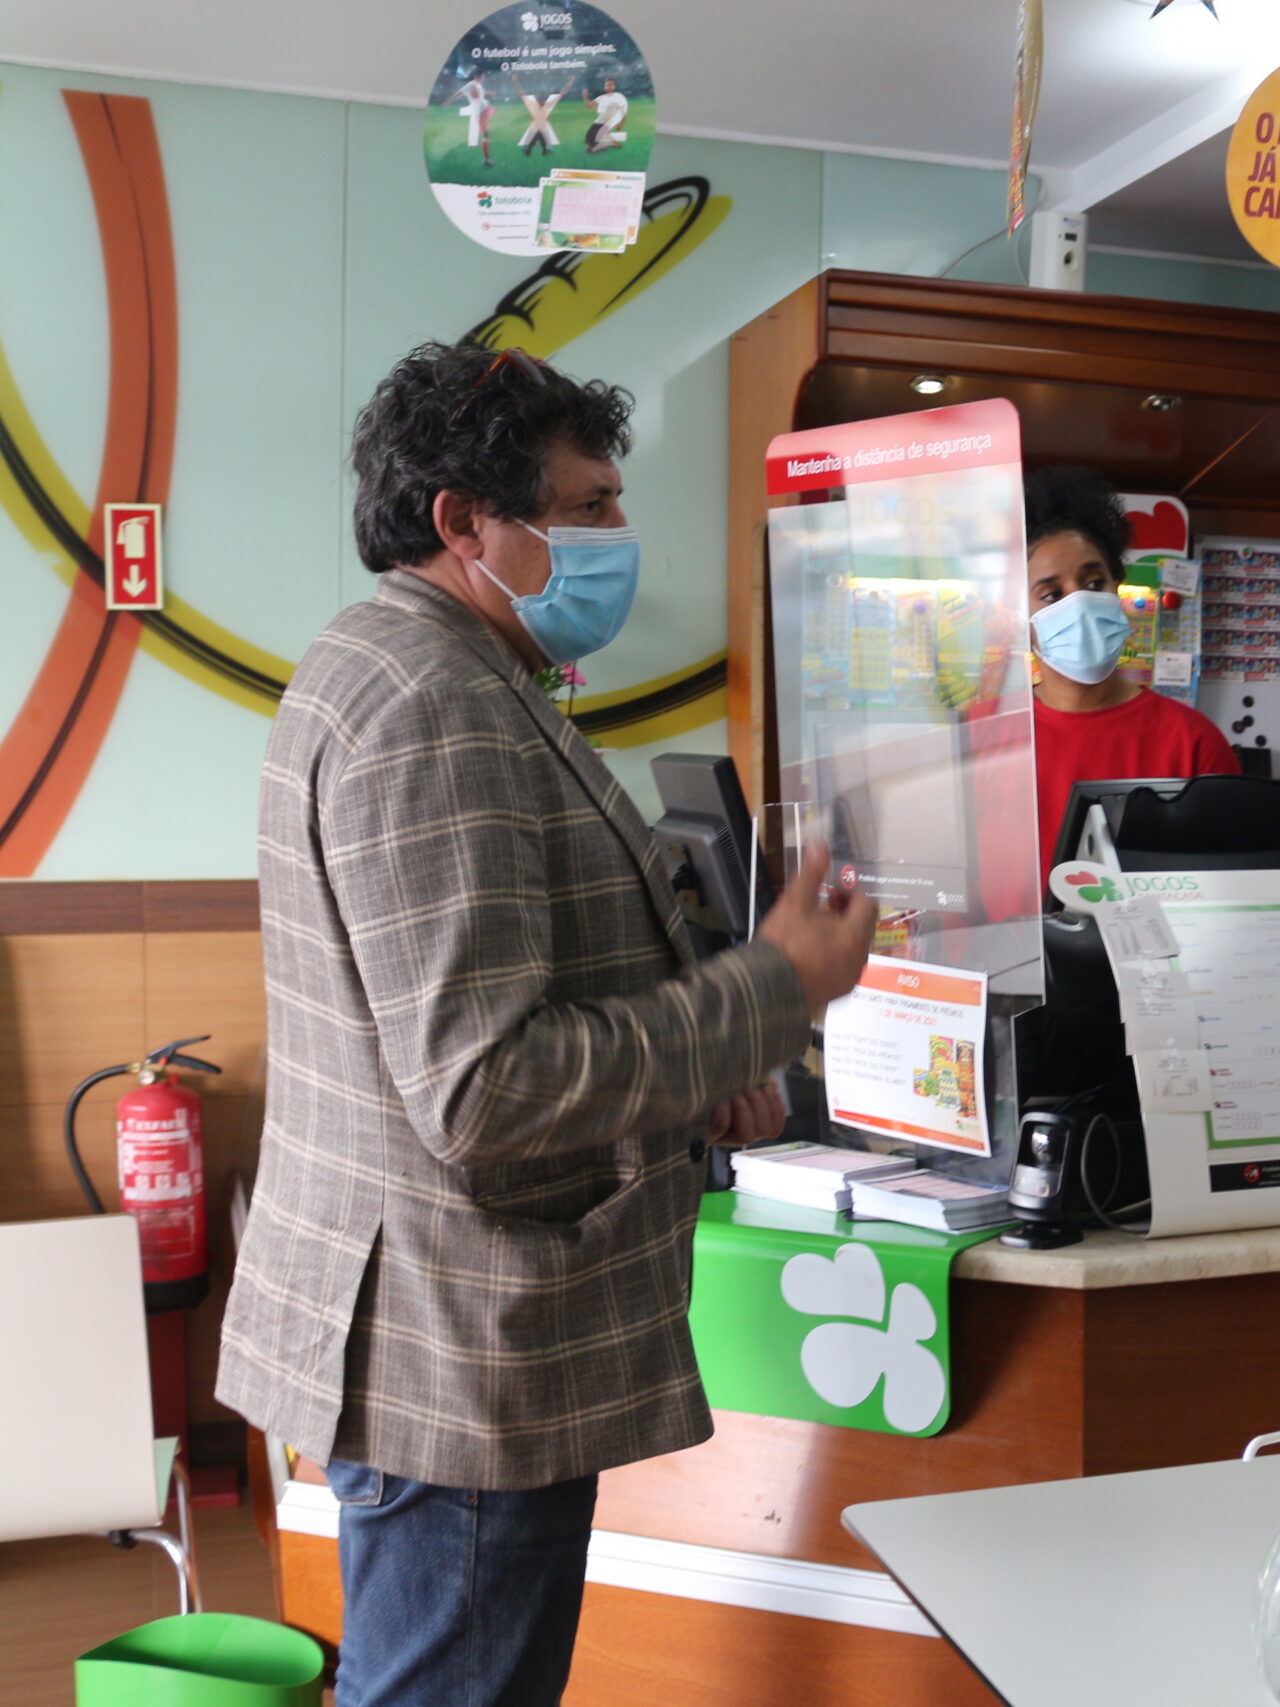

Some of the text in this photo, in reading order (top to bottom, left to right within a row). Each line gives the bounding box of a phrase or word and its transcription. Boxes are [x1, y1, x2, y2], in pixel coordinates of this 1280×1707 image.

[540, 12, 573, 28] JOGOS
[471, 43, 617, 58] O futebol é um jogo simples.
[501, 62, 509, 71] O
[511, 61, 548, 71] Totobola
[1256, 112, 1275, 144] O
[1248, 146, 1277, 183] JÁ
[787, 434, 992, 478] Mantenha a distância de segurança
[1124, 875, 1200, 897] JOGOS
